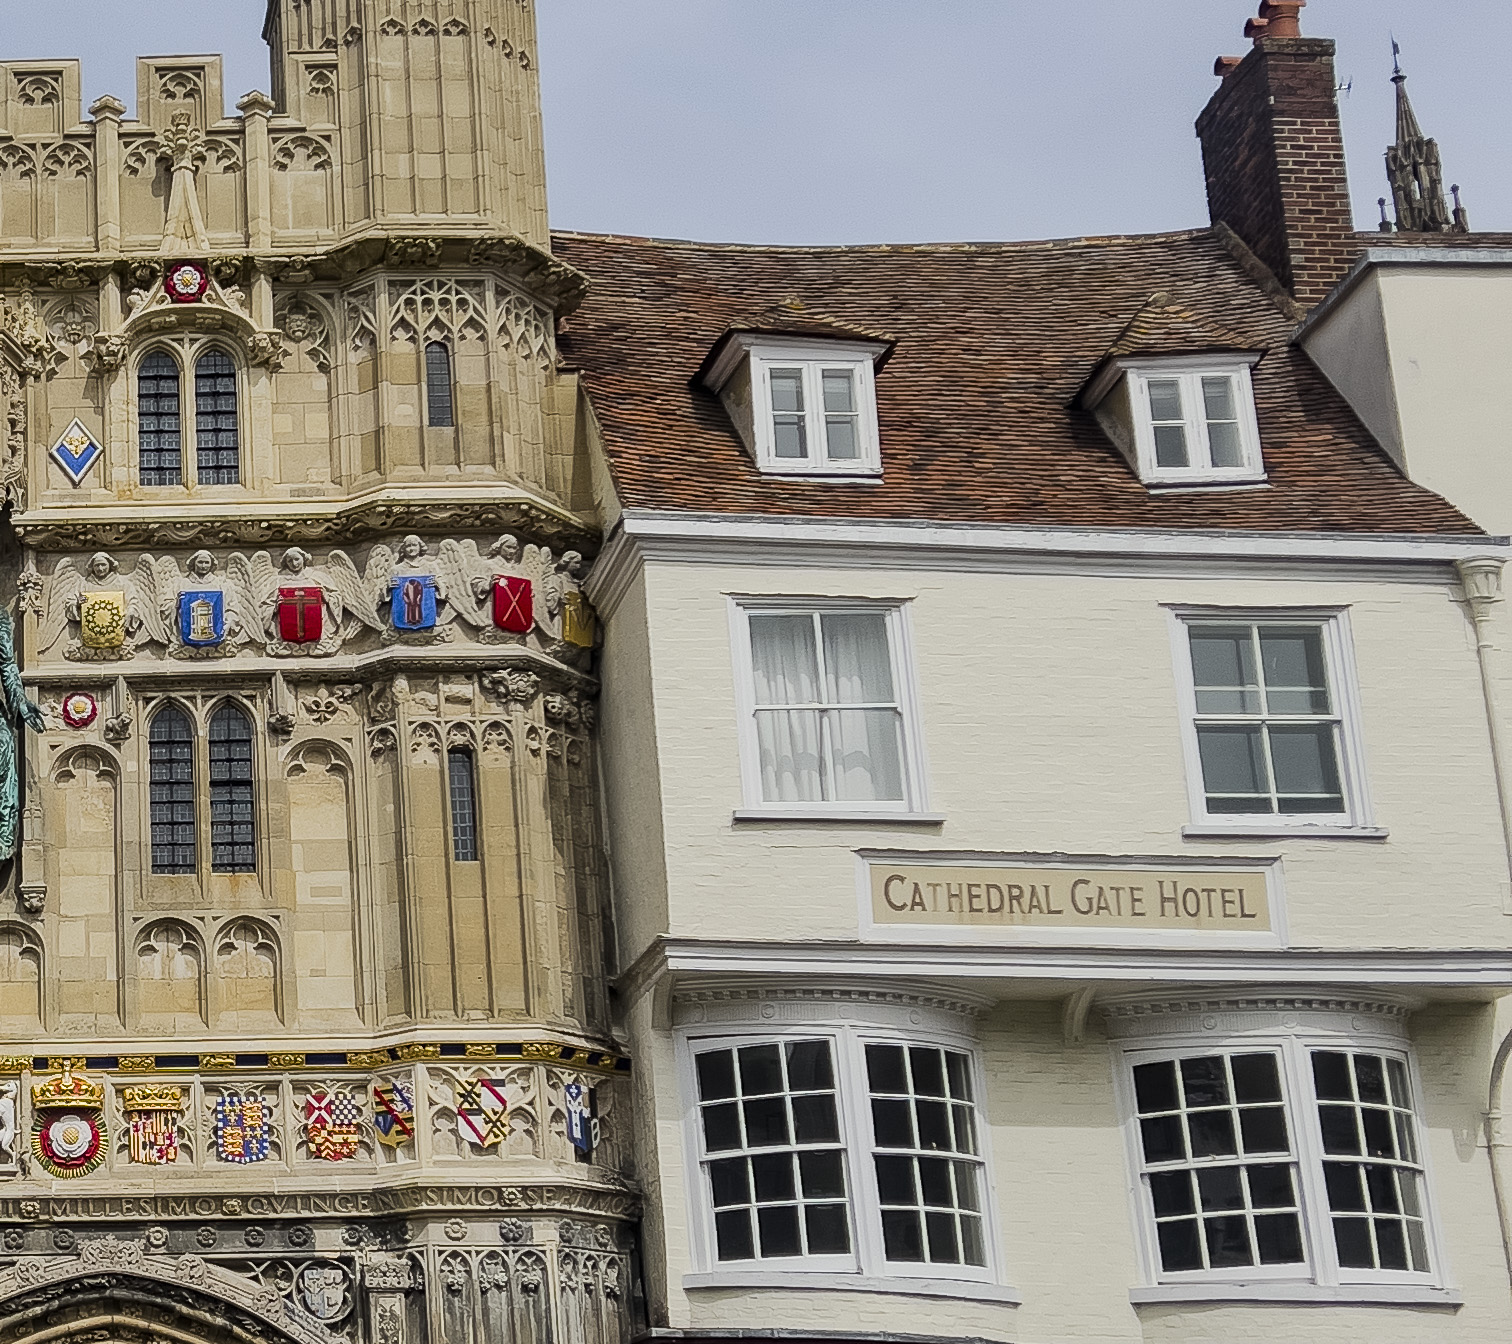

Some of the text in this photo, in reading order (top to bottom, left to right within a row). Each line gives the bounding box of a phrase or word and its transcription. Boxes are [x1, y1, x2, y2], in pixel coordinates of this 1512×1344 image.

[884, 874, 1257, 919] CATHEDRAL GATE HOTEL
[49, 1197, 216, 1217] MILLESIMO
[247, 1187, 498, 1215] QVINGENTESIMO
